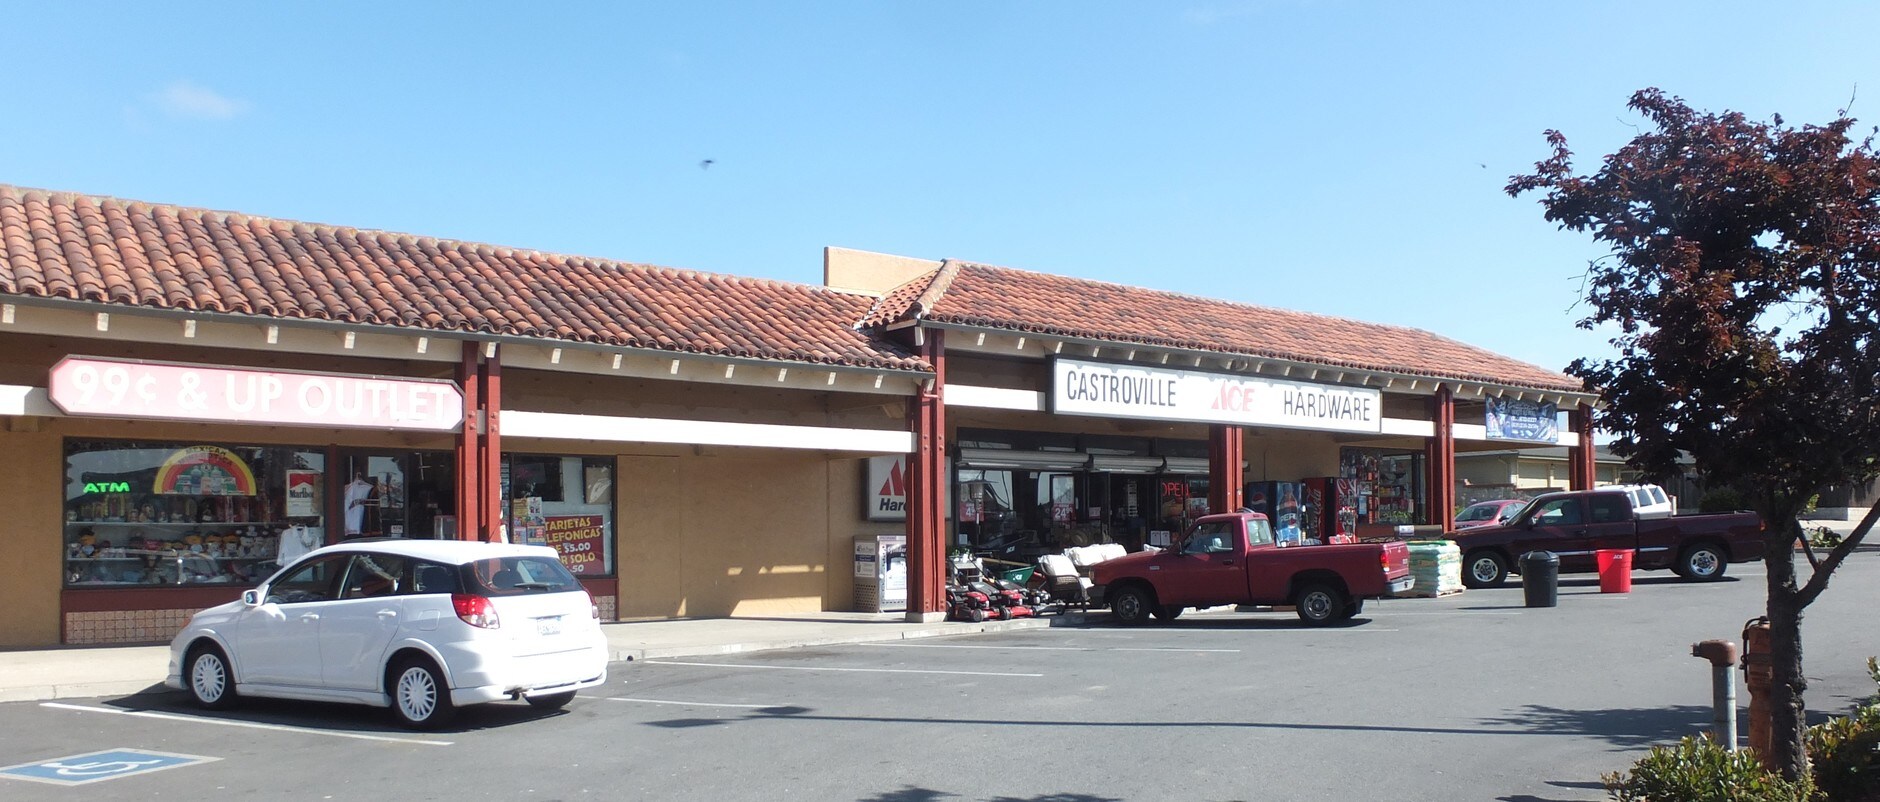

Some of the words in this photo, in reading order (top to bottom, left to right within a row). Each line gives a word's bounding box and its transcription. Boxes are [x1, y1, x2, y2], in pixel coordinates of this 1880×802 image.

[177, 371, 209, 411] &
[226, 374, 283, 413] UP
[298, 378, 450, 422] OUTLET
[1067, 370, 1176, 407] CASTROVILLE
[1211, 380, 1255, 411] ACE
[1284, 390, 1370, 421] HARDWARE
[83, 481, 130, 493] ATM
[545, 517, 591, 531] TARJETAS
[546, 528, 600, 542] LEFONICAS
[564, 542, 591, 554] $5.00
[570, 552, 595, 563] SOLO
